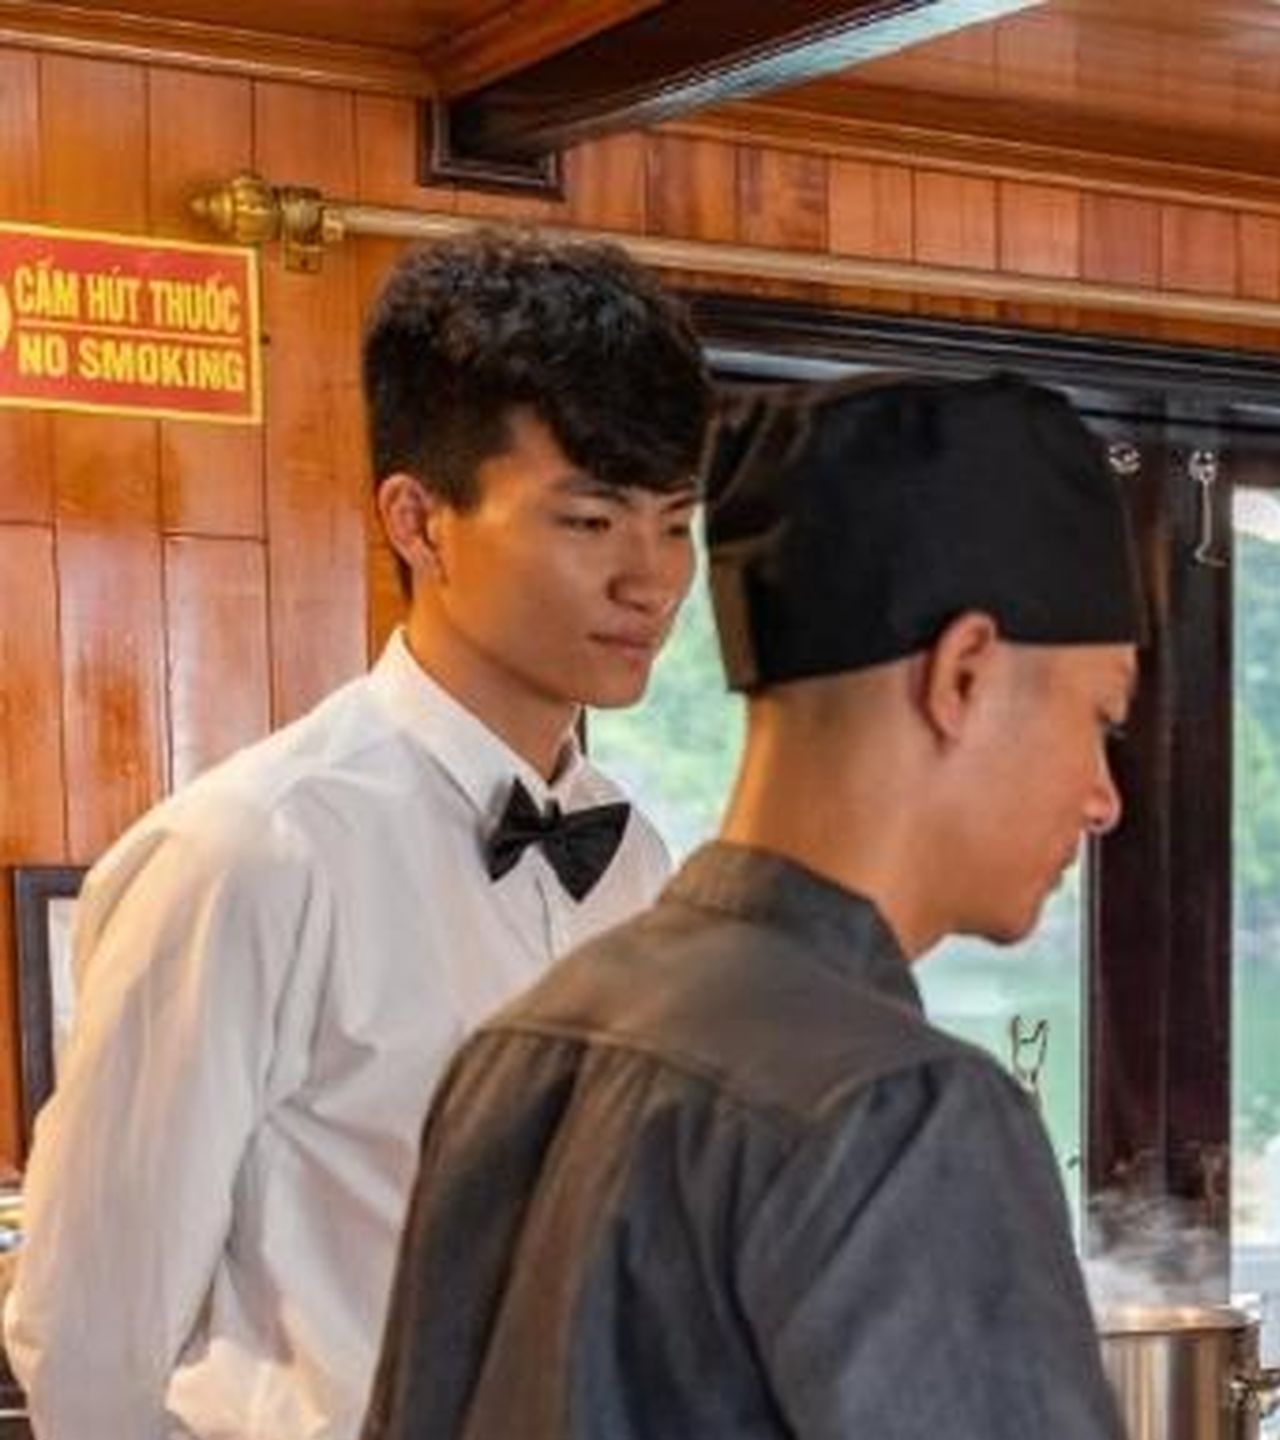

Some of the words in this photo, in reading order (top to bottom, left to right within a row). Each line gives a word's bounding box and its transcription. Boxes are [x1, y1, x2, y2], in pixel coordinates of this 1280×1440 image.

[85, 265, 142, 324] HÚT
[17, 332, 70, 376] NO
[78, 337, 245, 392] SMOKING
